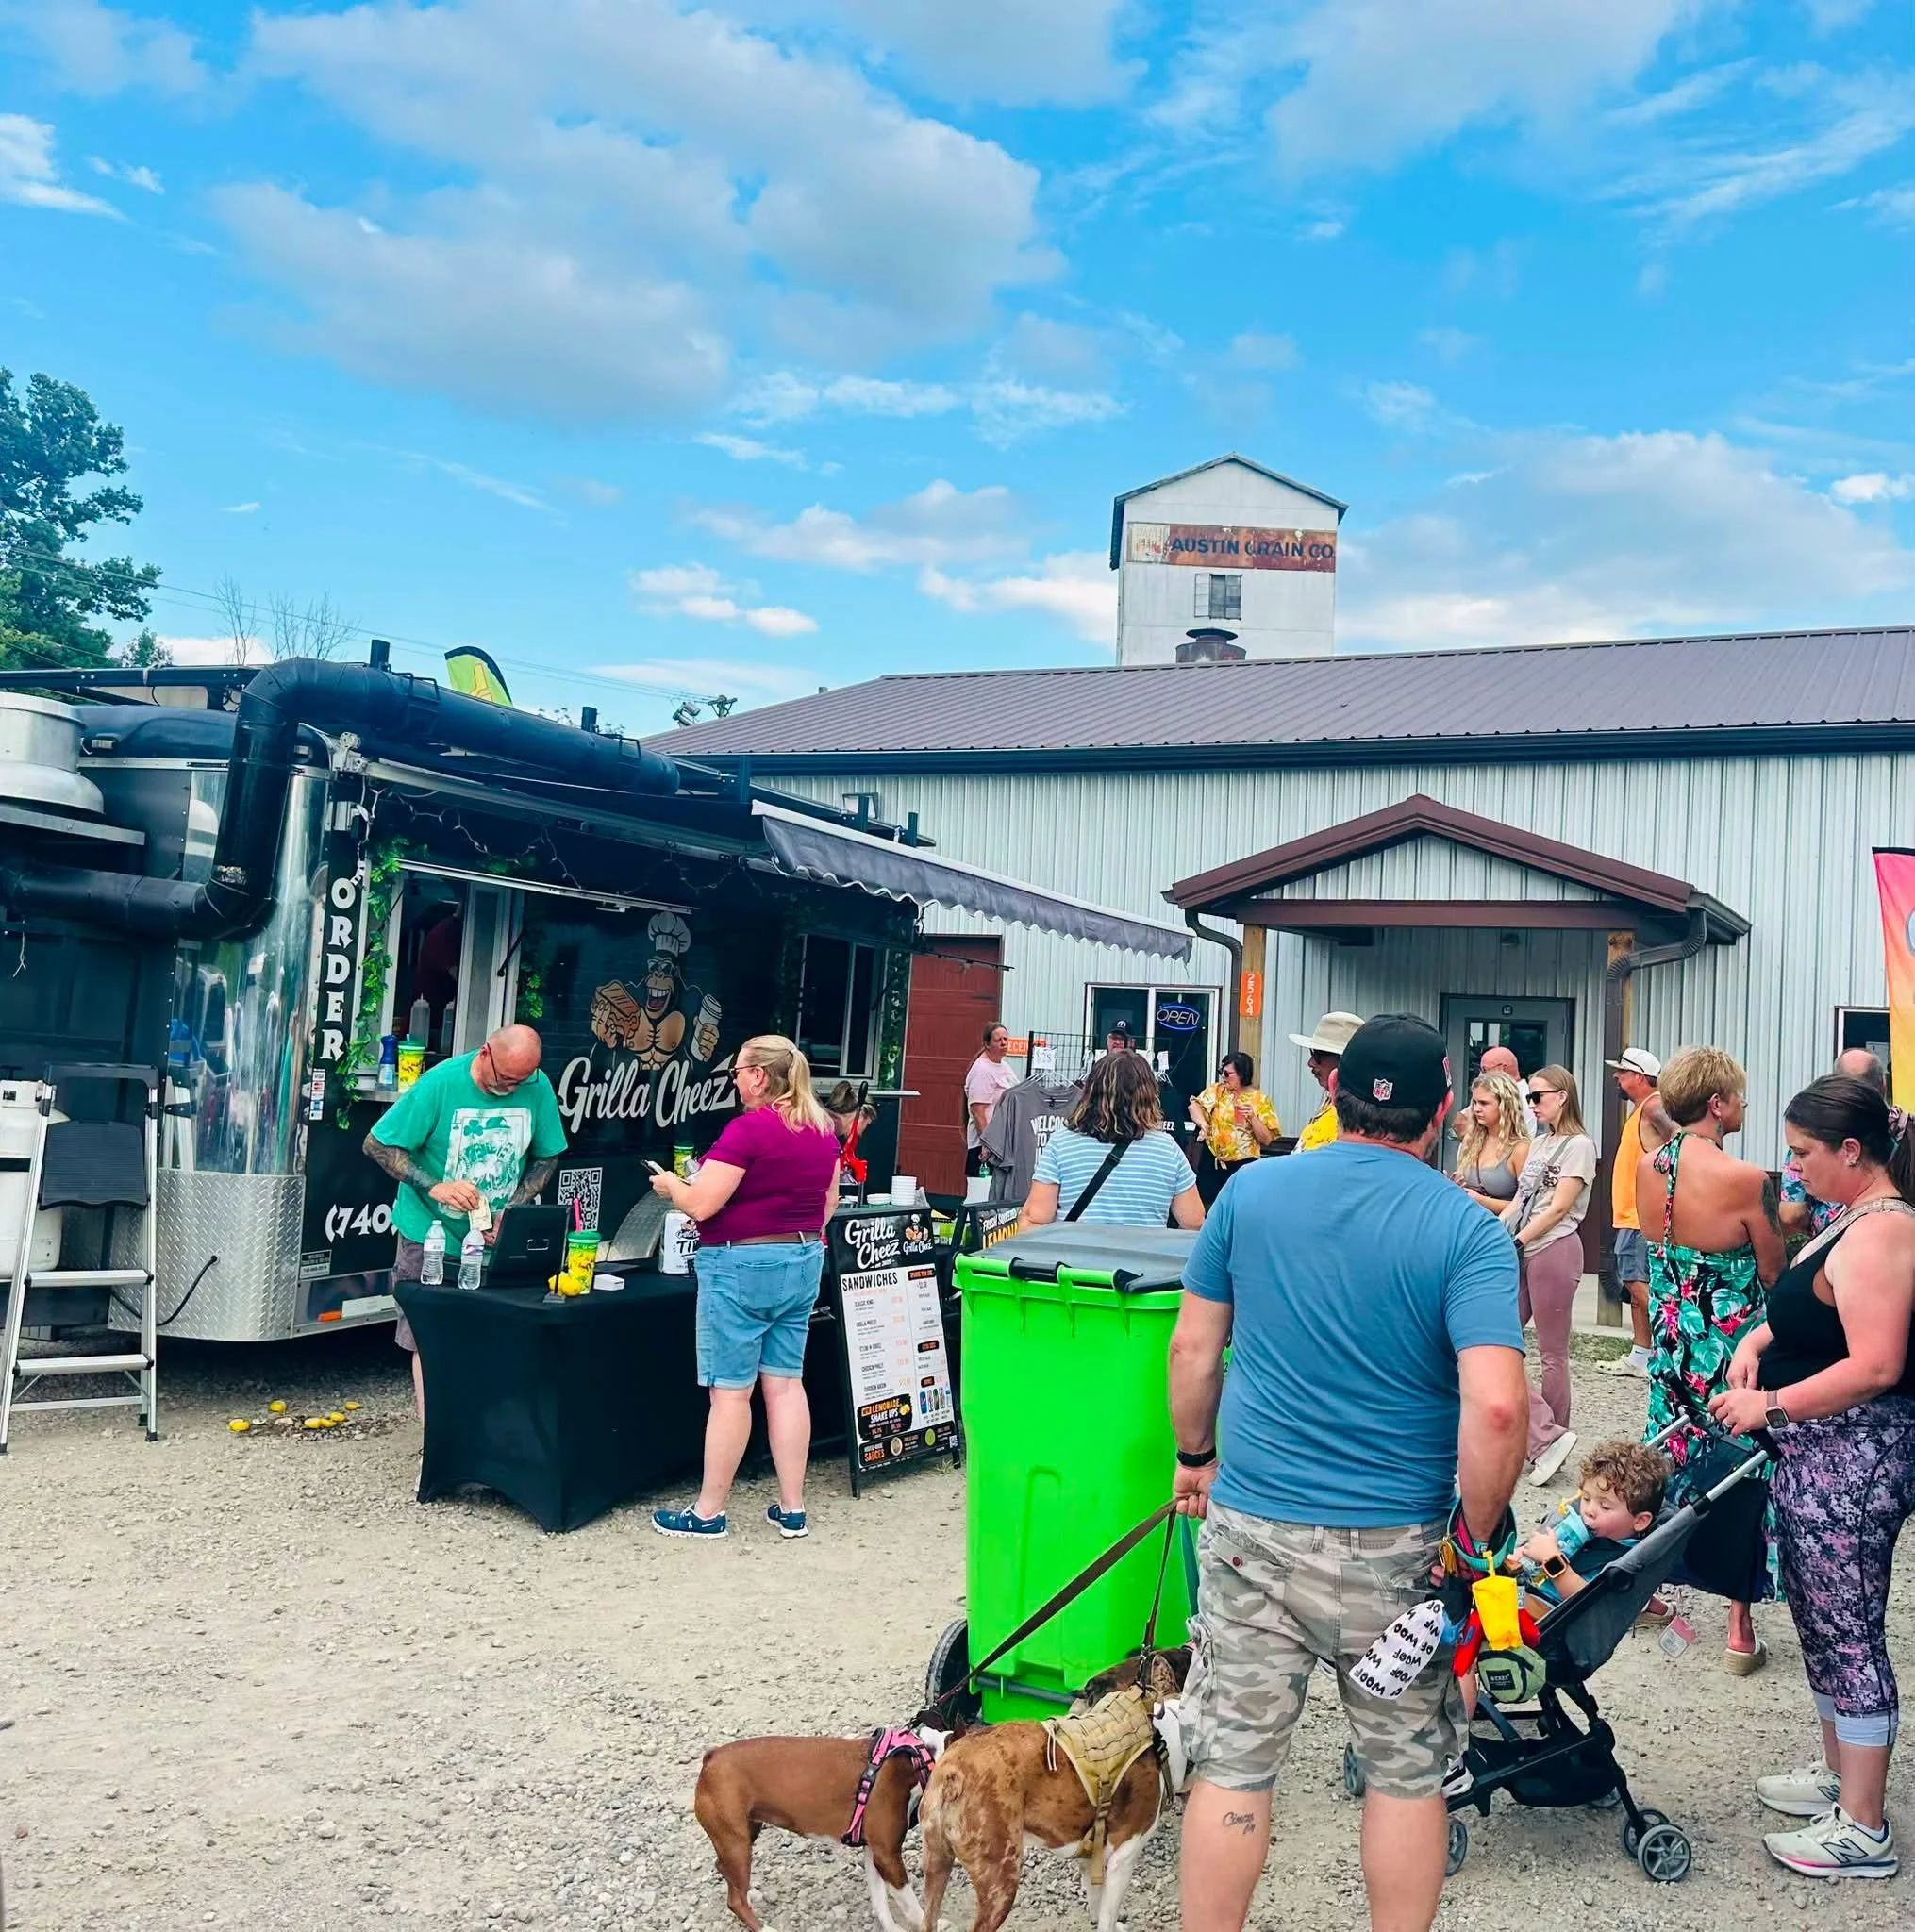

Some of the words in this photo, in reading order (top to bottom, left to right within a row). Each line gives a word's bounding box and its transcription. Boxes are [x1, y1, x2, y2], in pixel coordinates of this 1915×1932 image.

[1171, 538, 1240, 555] AUSTIN
[1244, 541, 1304, 558] GRAIN
[320, 877, 357, 1062] ORDER
[1245, 973, 1256, 1016] 2564
[1157, 1008, 1200, 1026] OPEN
[558, 1056, 651, 1134] Grilla
[1030, 1115, 1065, 1135] WELCO
[1037, 1132, 1047, 1148] TO
[844, 1217, 896, 1249] Grilla
[857, 1238, 902, 1270] Cheez
[841, 1271, 898, 1291] SANDWICHES
[872, 1398, 900, 1414] LEMONADE
[1354, 1667, 1386, 1696] WOOF
[1821, 1838, 1869, 1864] N
